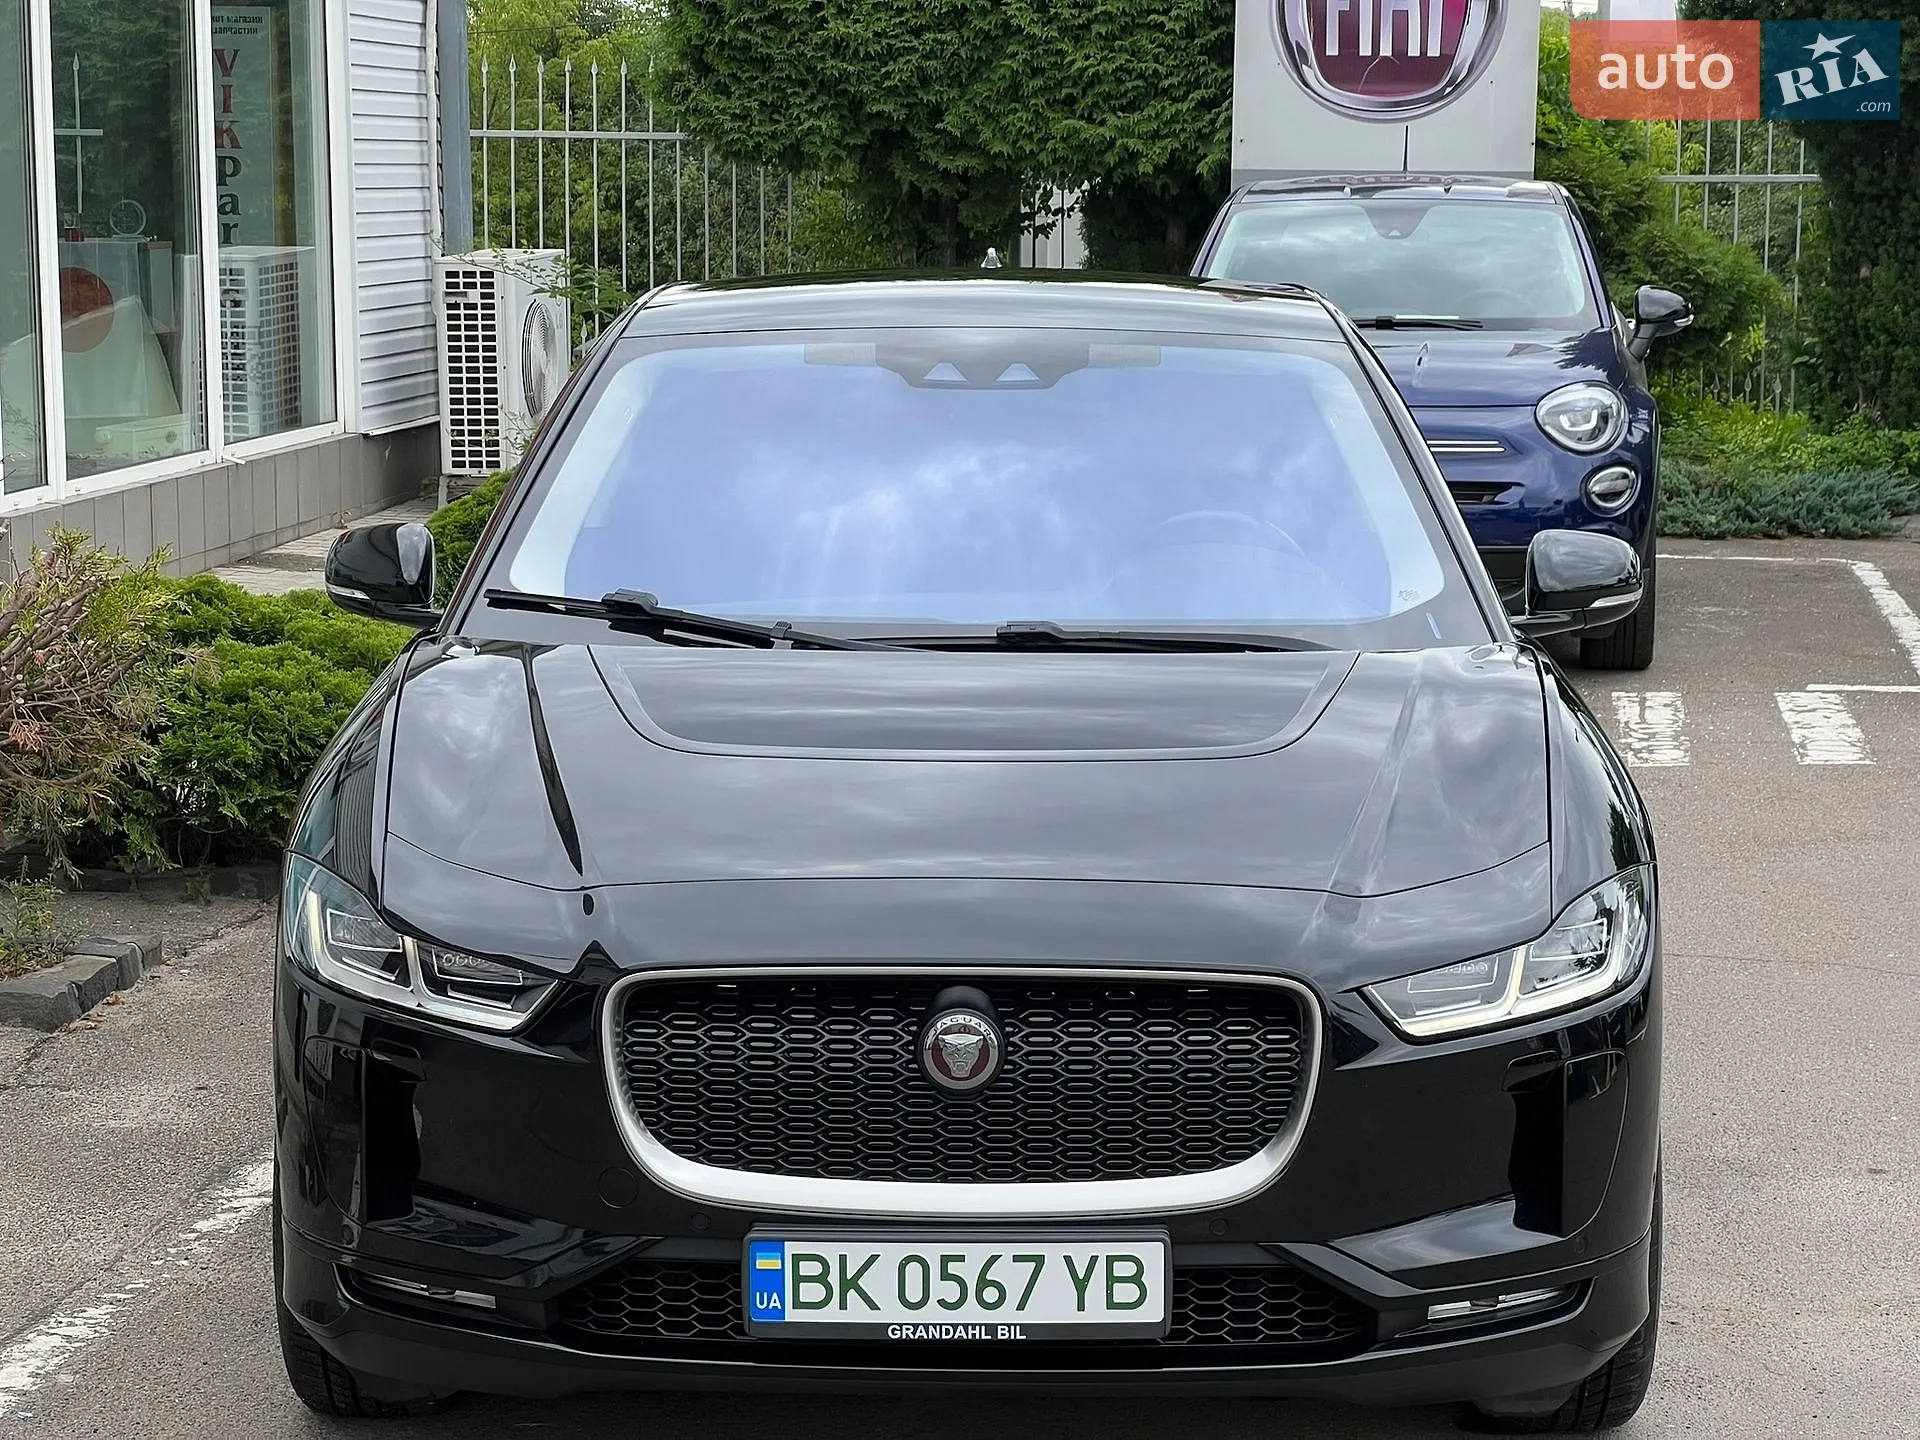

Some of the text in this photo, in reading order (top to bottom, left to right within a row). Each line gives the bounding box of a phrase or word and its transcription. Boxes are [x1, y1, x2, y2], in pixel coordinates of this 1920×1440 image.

[932, 1016, 993, 1037] JAGUAR
[791, 1253, 1148, 1312] BK 0567 YB
[755, 1291, 782, 1310] UA
[887, 1324, 1027, 1340] GRANDAHL BIL
